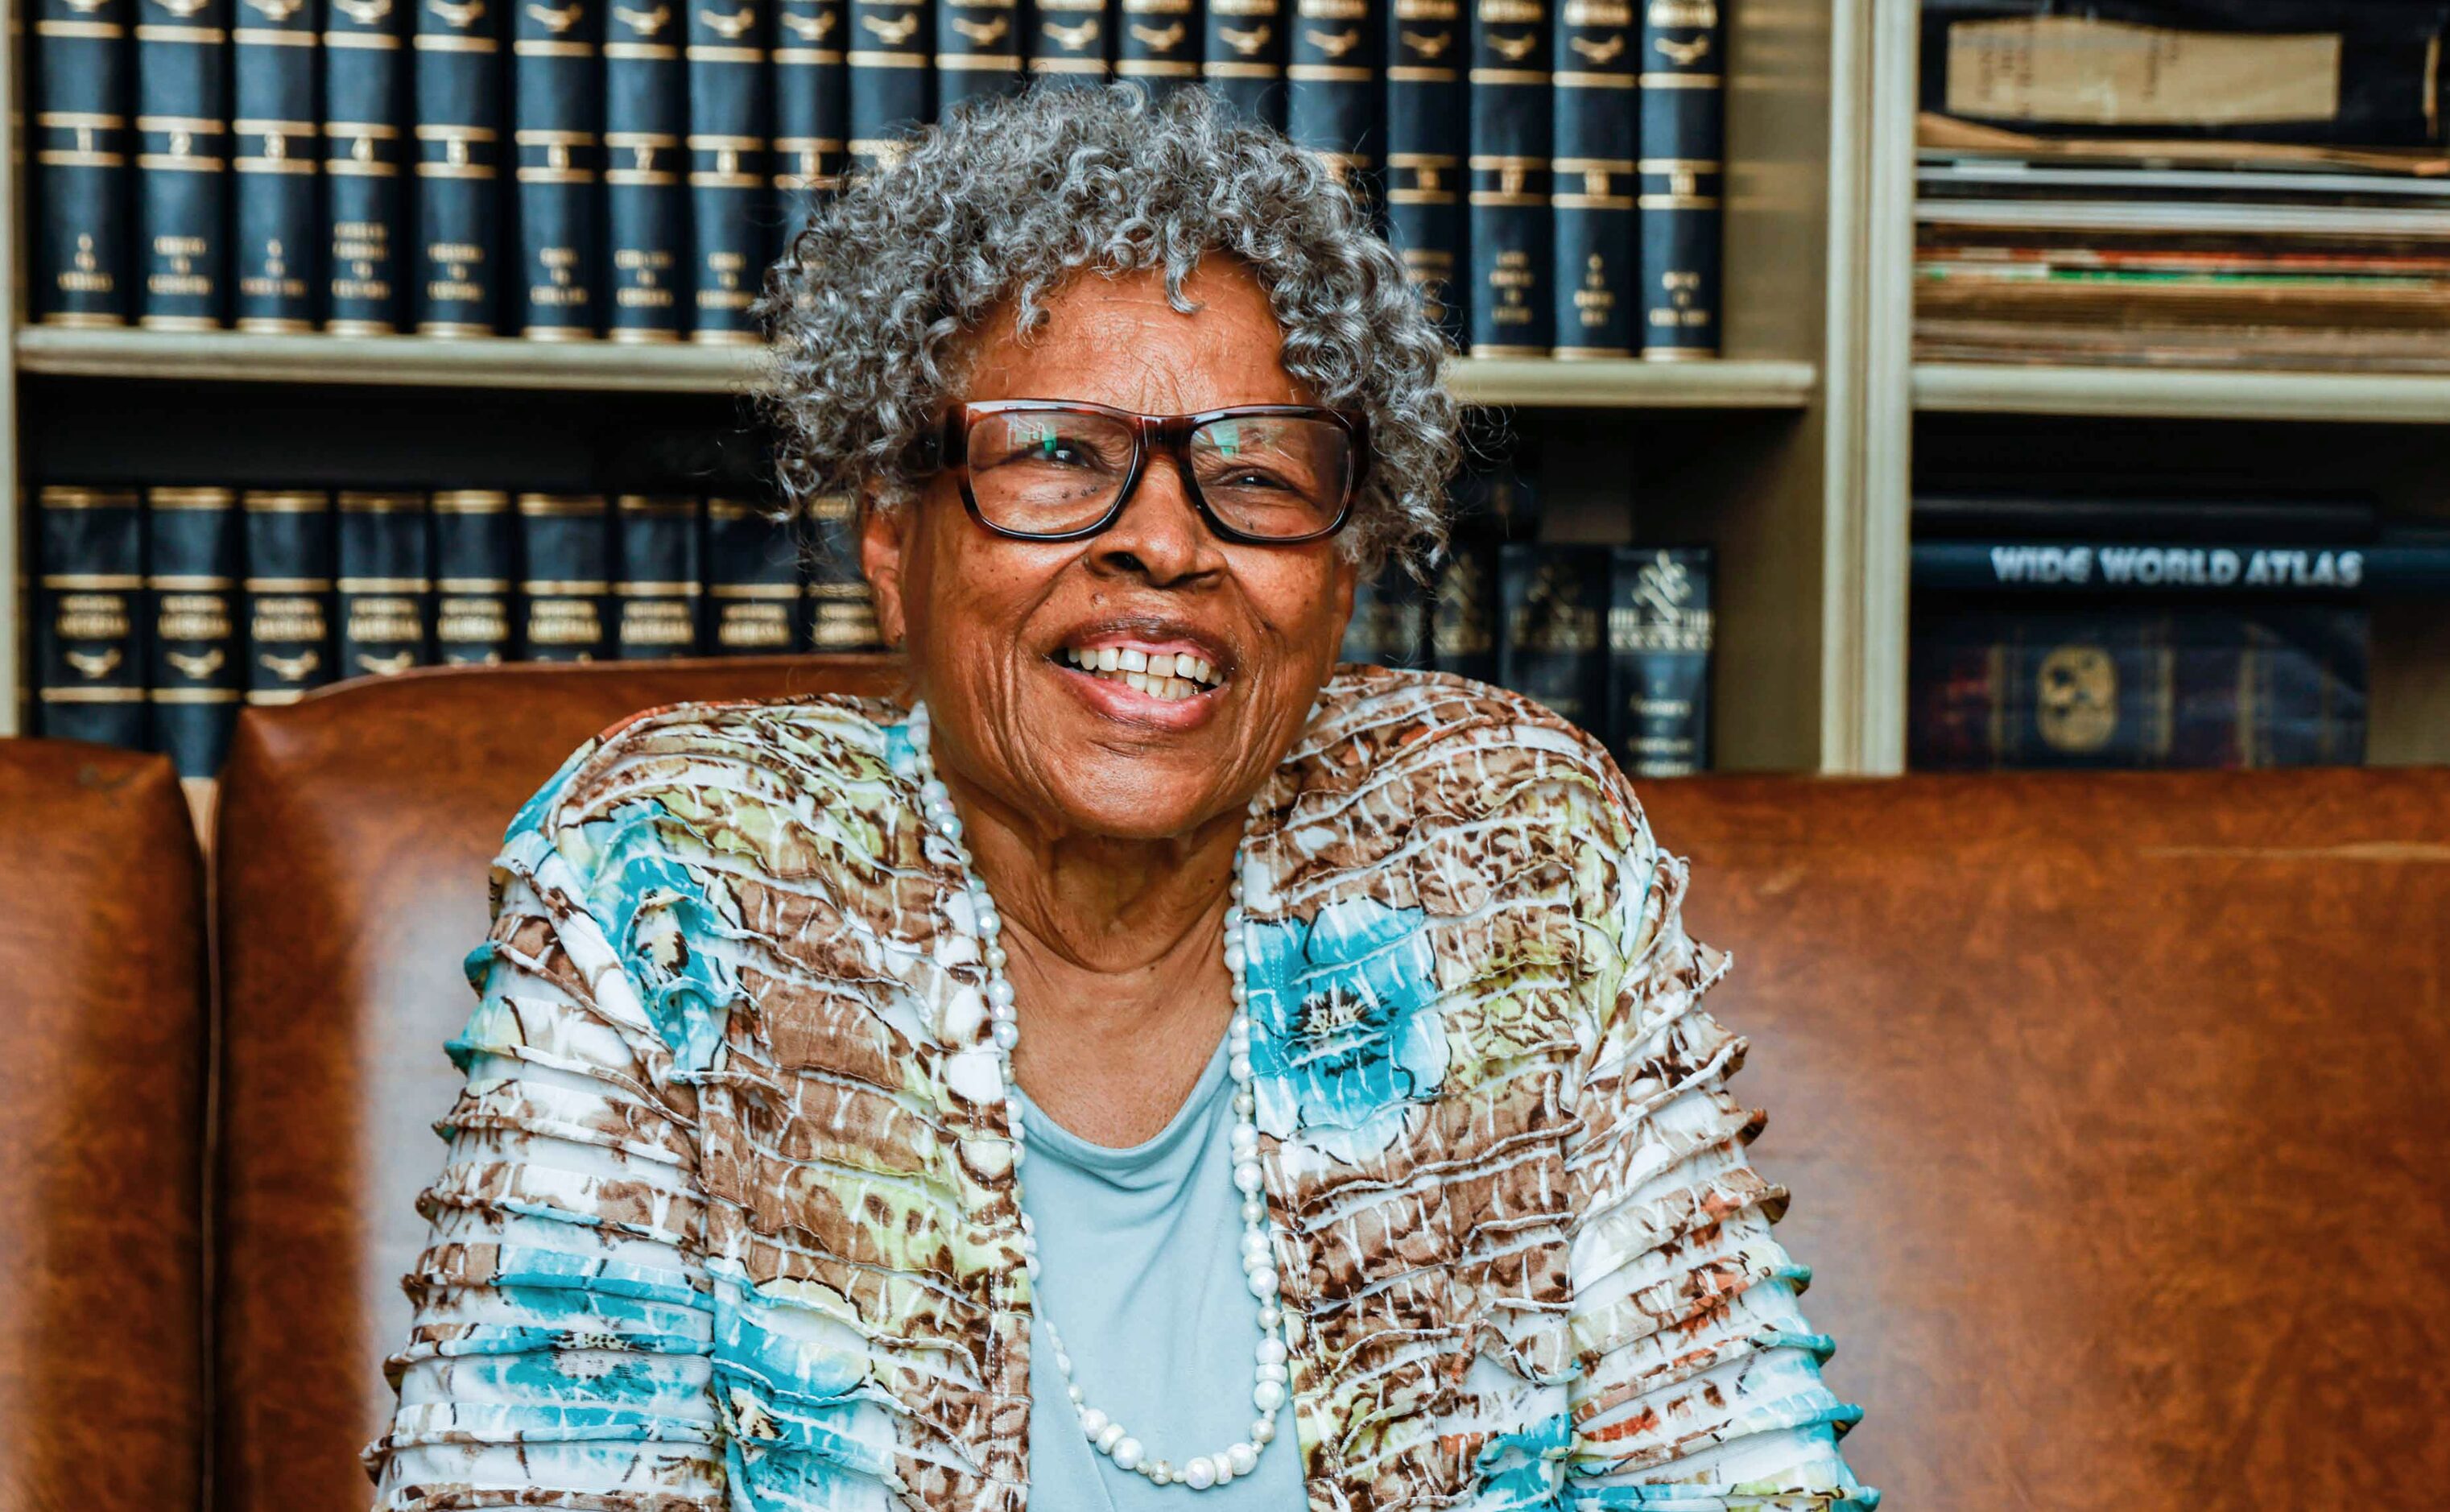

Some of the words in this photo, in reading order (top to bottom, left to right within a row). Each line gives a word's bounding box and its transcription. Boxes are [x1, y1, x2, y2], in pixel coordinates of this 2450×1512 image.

[1989, 546, 2093, 583] WIDE
[2098, 547, 2241, 585] WORLD
[2245, 549, 2365, 588] ATLAS
